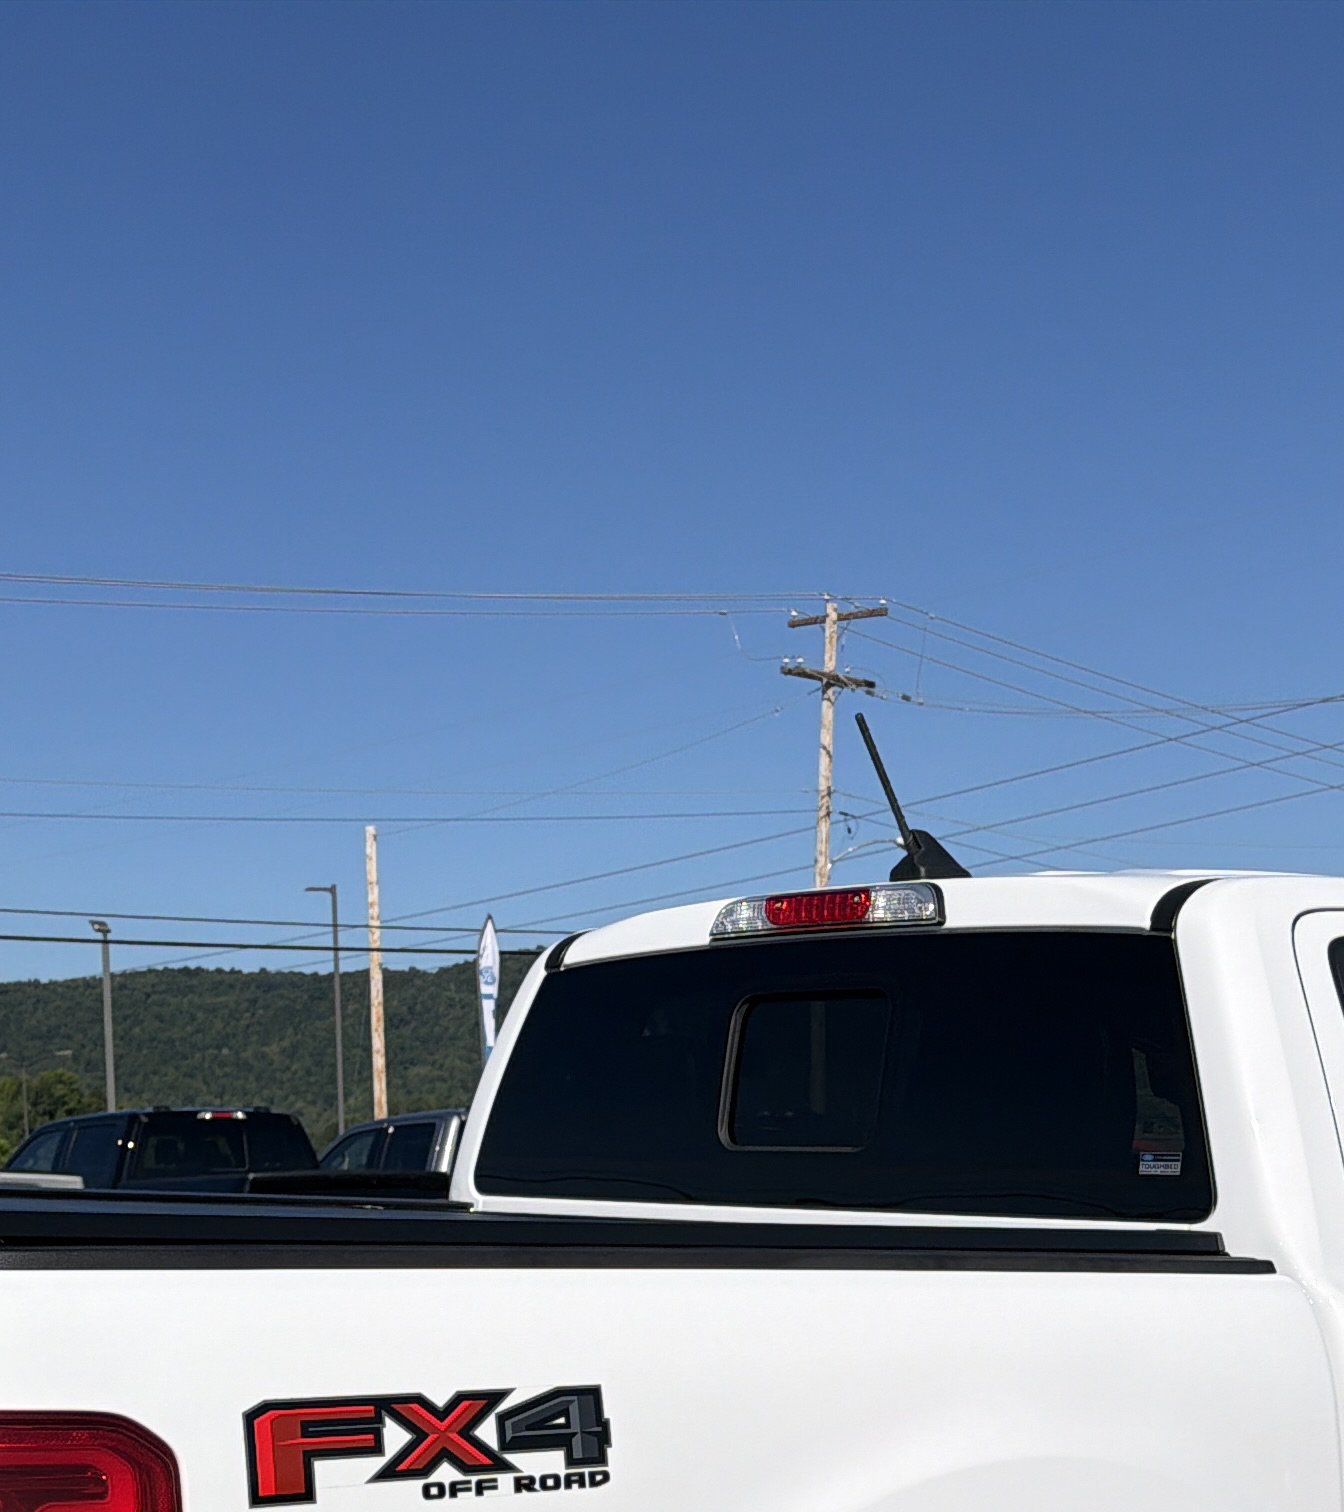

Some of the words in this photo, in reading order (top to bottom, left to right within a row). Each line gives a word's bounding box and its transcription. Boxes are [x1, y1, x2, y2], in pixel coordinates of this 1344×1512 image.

[242, 1383, 613, 1509] FX4
[421, 1477, 499, 1501] OFF
[513, 1469, 611, 1494] ROAD
